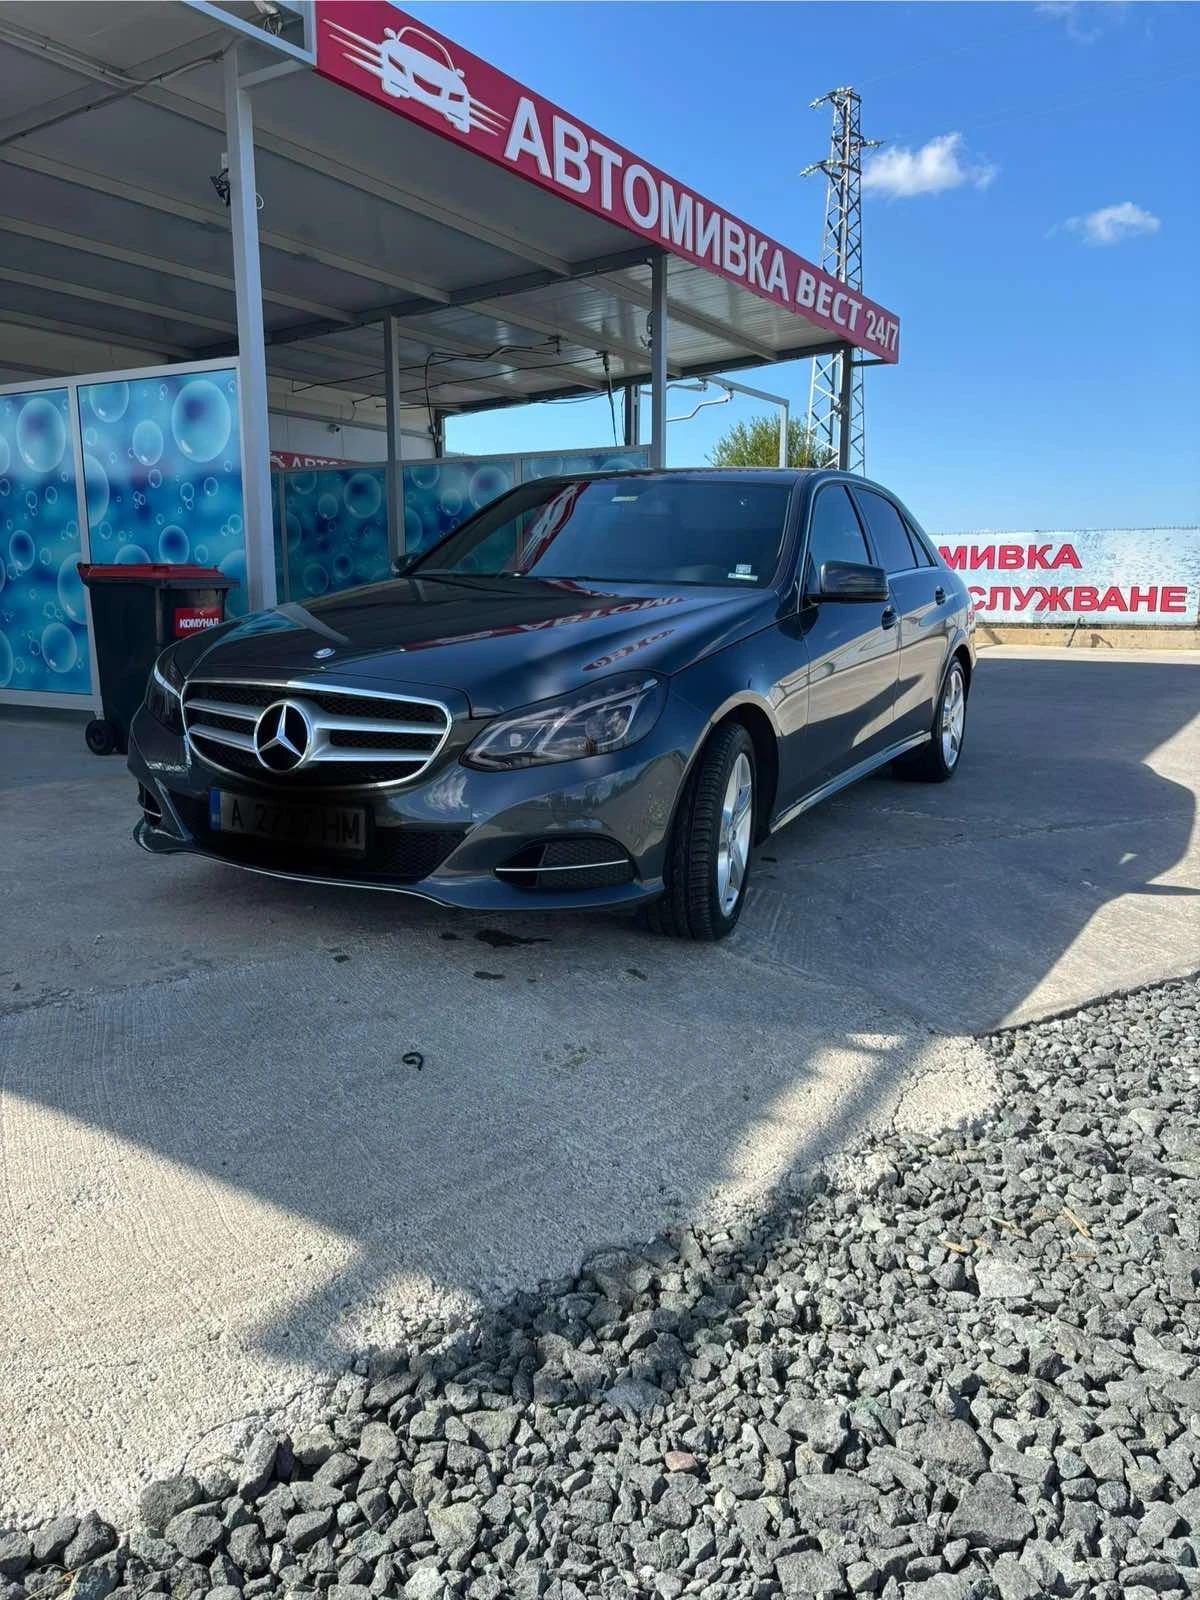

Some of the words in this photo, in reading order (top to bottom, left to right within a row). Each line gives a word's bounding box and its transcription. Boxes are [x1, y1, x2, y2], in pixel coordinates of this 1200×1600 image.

[504, 97, 789, 301] АВТОМИВКА
[796, 269, 862, 332] ВЕСТ
[864, 309, 899, 352] 24/7
[938, 544, 1082, 570] МИВКА
[967, 586, 1188, 613] СЛУЖВАНЕ
